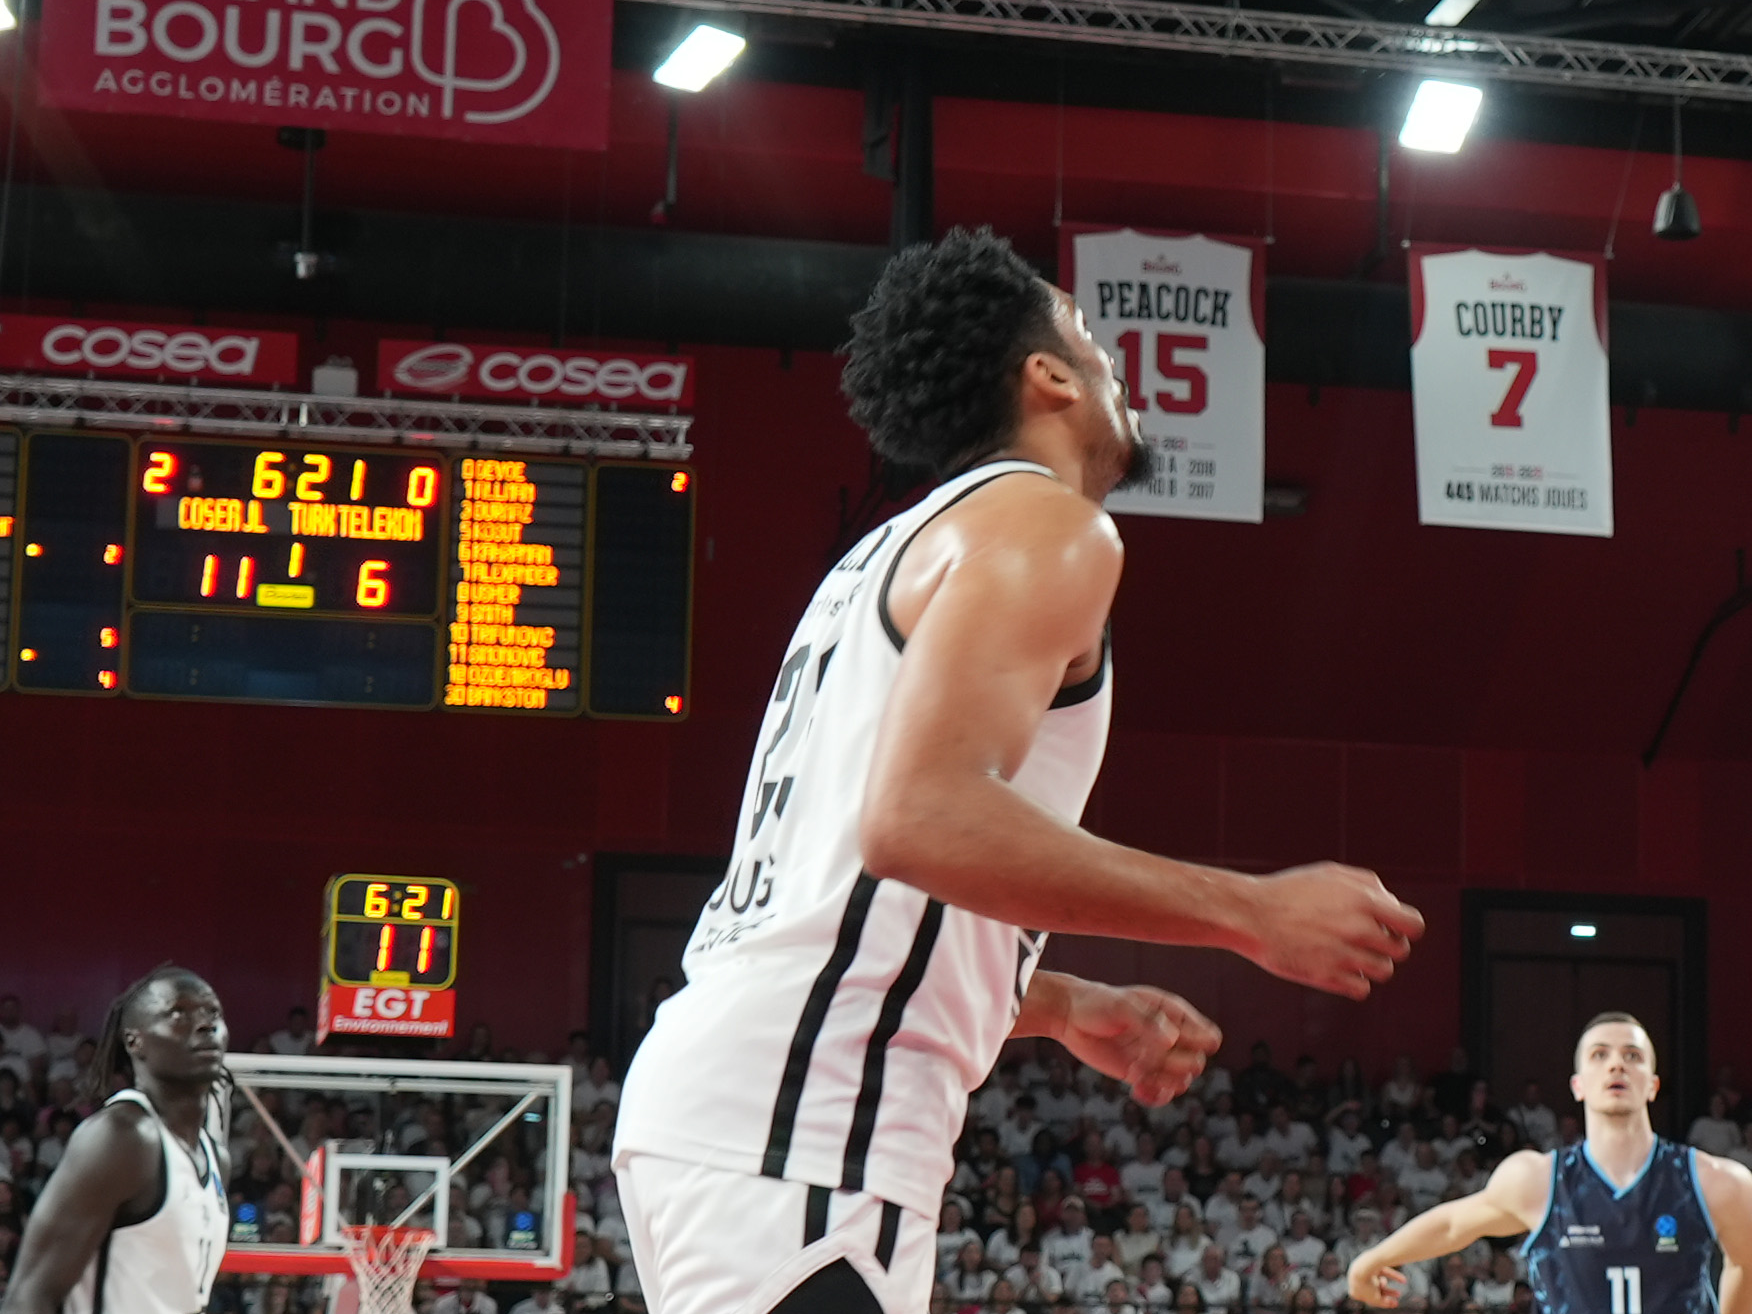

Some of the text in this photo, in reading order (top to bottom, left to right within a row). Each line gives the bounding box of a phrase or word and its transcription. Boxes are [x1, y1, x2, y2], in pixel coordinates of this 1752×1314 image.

[93, 67, 431, 118] AGGLOMÉRATION
[1096, 280, 1232, 329] PEACOCK
[1456, 301, 1564, 342] COURBY
[42, 324, 261, 375] cosea
[1116, 329, 1209, 416] 15
[478, 352, 689, 401] cosea
[1488, 348, 1538, 429] 7
[143, 451, 177, 493] 2
[406, 466, 439, 507] 0
[288, 542, 305, 578] 1
[356, 559, 392, 608] 6
[449, 643, 467, 664] 11
[353, 989, 431, 1019] EGT
